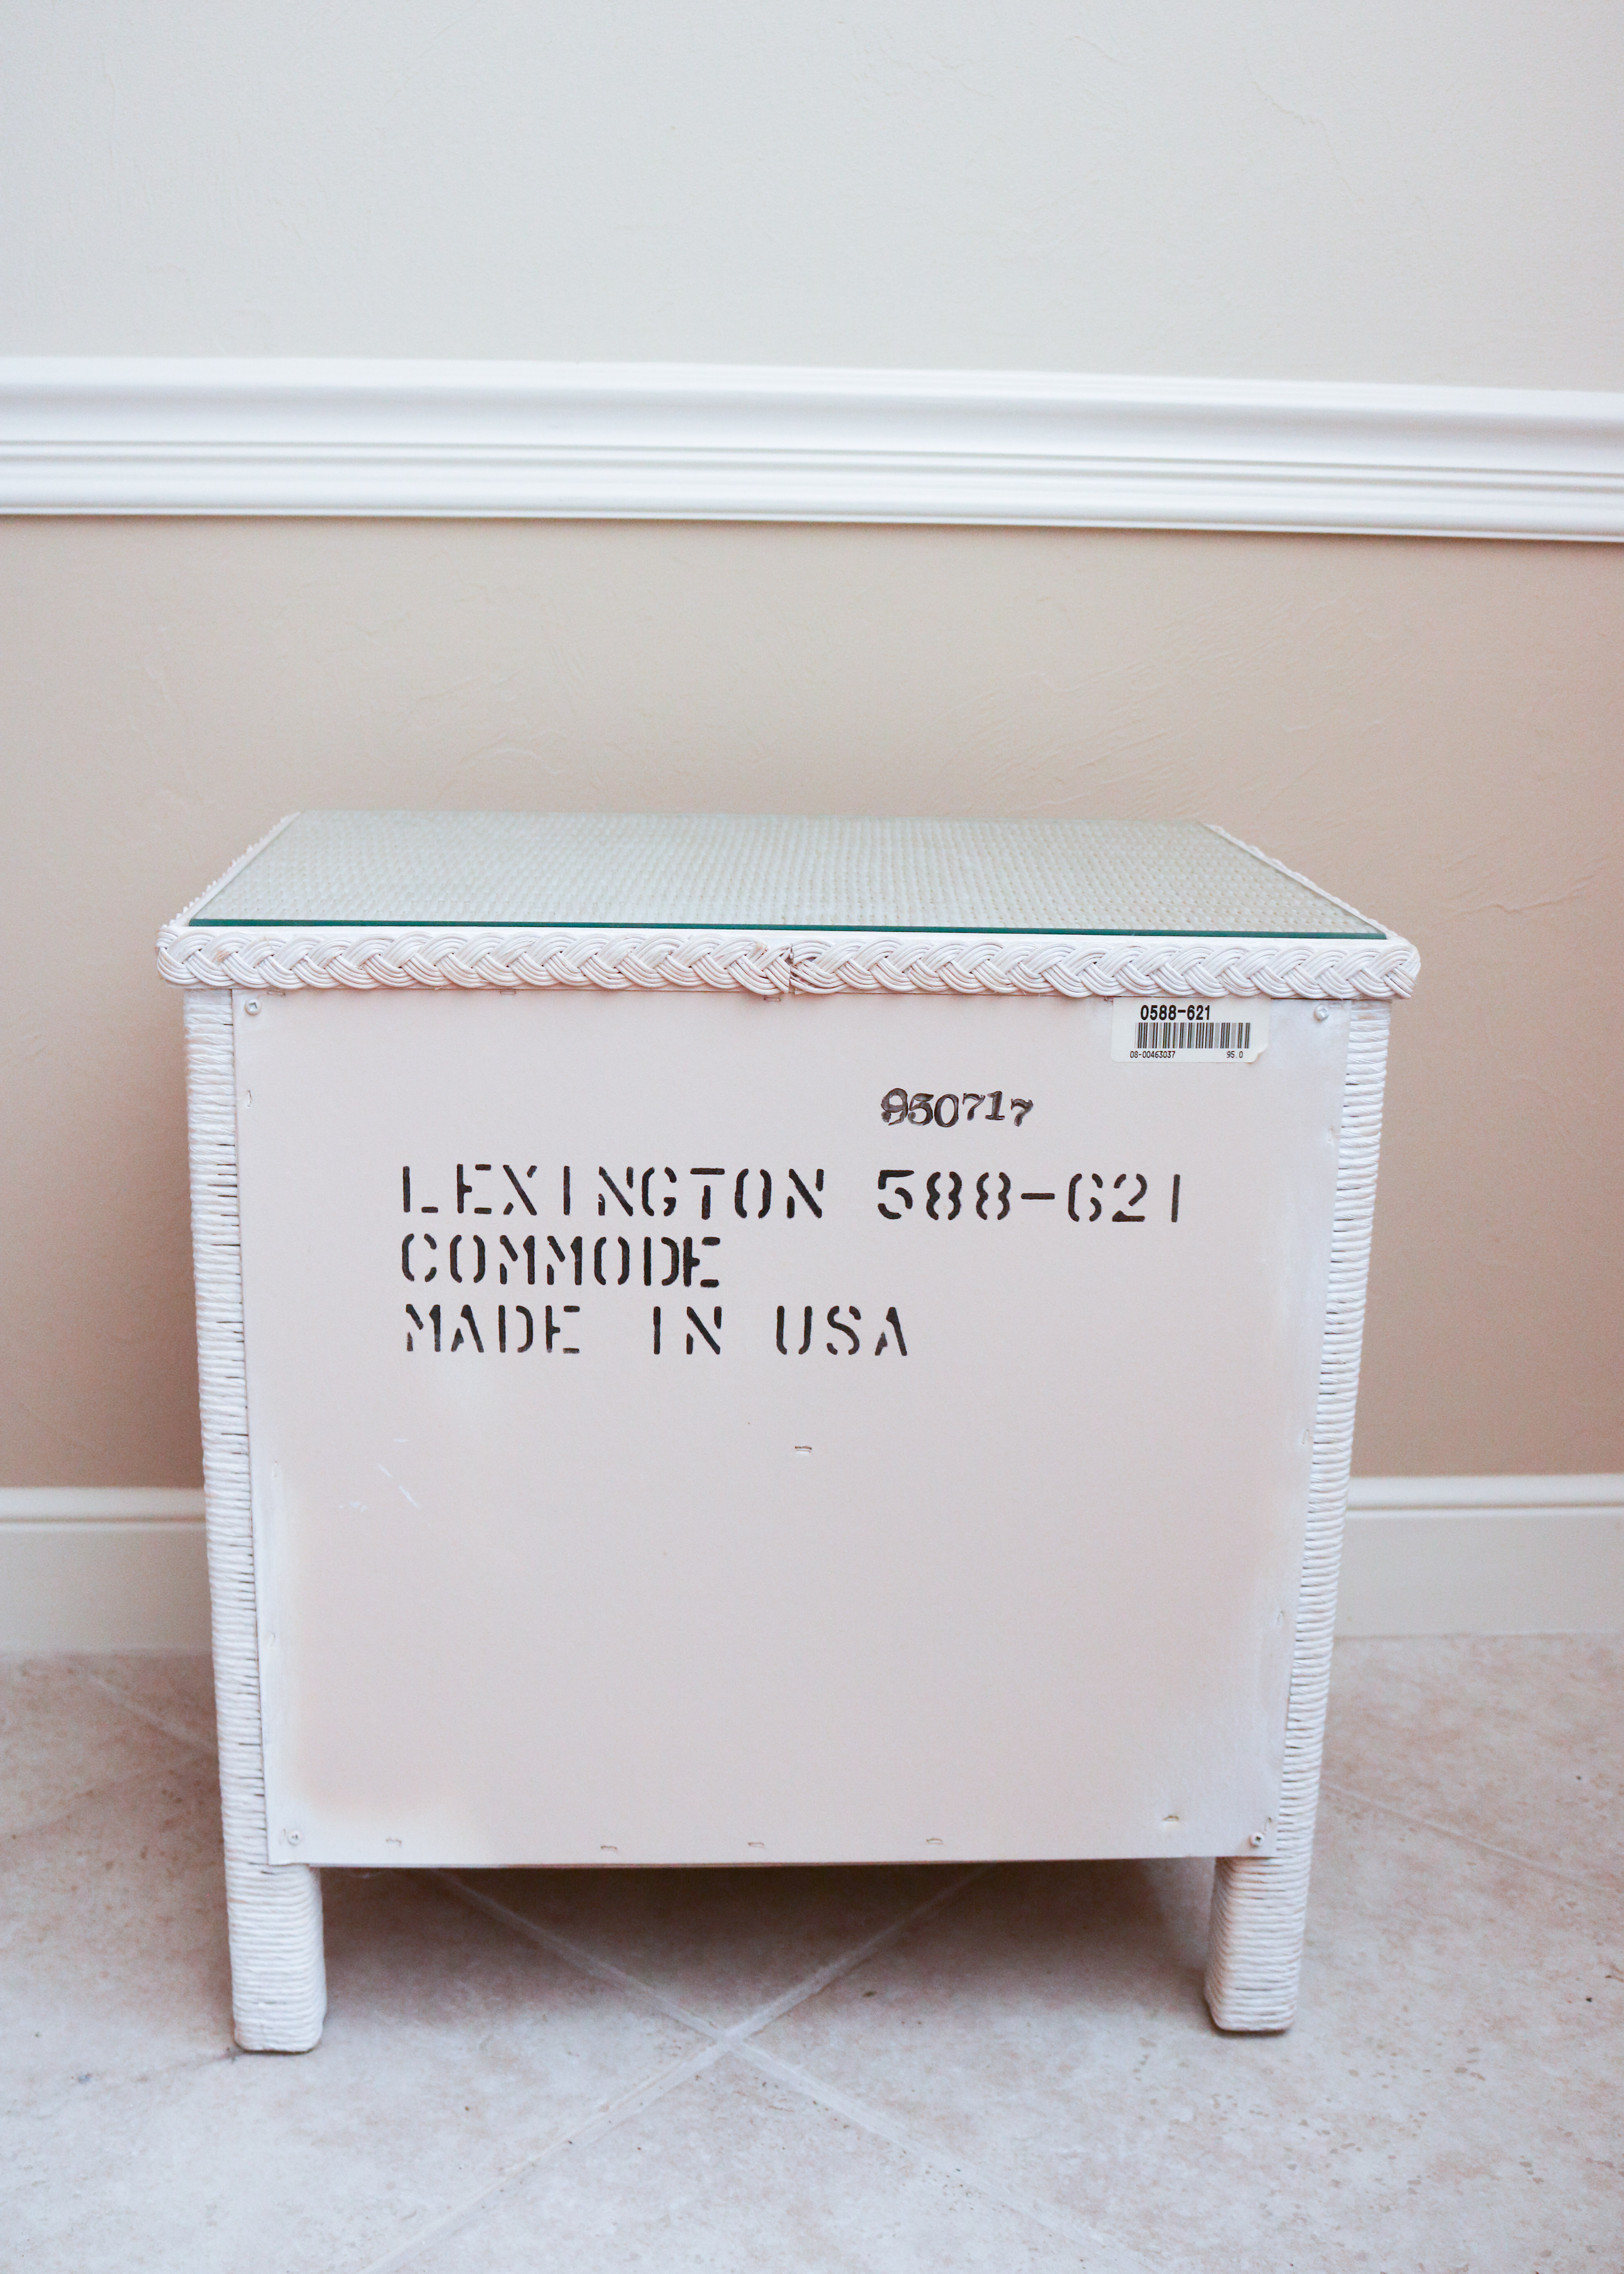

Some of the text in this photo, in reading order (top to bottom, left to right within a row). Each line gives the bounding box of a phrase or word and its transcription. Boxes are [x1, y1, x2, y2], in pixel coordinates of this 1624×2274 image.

[1140, 1005, 1210, 1021] 0588-621
[881, 1087, 1033, 1128] 950717
[403, 1163, 1181, 1223] LEXINGTON 588-621
[402, 1233, 720, 1288] COMMODE
[405, 1304, 909, 1357] MADE IN USA
